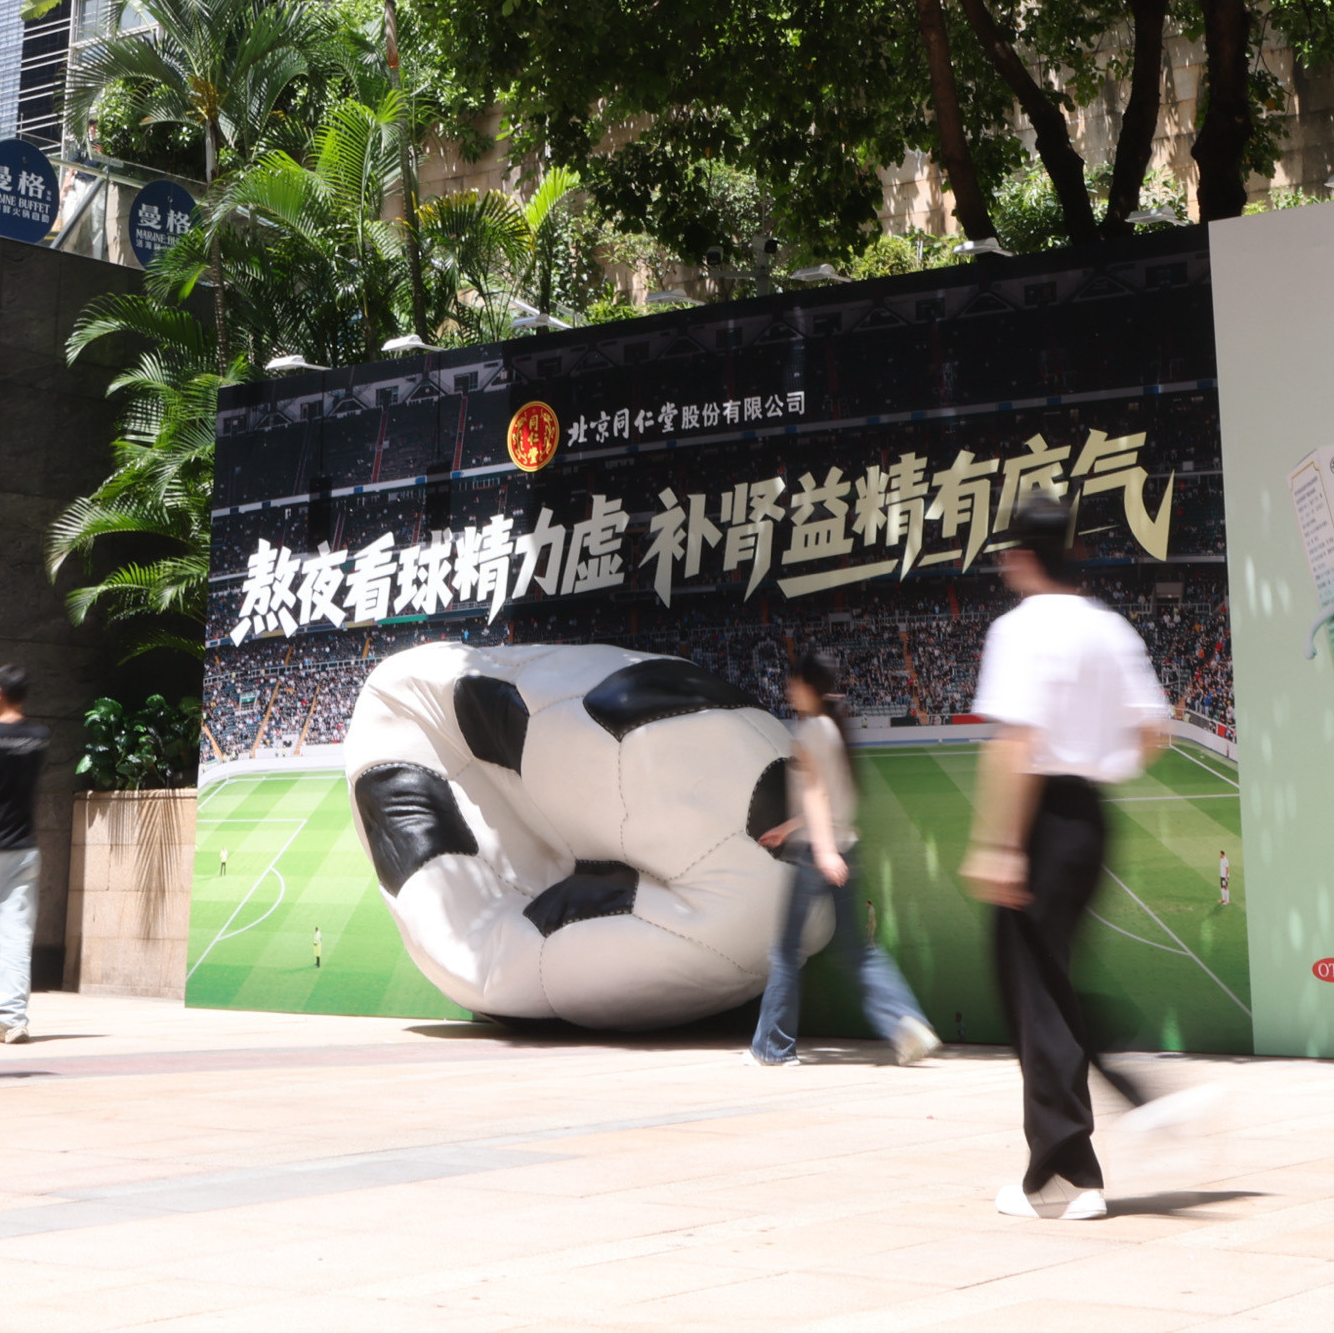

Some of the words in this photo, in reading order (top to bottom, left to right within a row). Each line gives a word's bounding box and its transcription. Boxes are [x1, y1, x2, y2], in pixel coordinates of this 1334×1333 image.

[18, 197, 50, 214] BUFFET
[137, 203, 191, 235] 曼格
[136, 228, 166, 244] MARINE
[567, 391, 806, 448] 北京同仁堂股份有限公司
[229, 494, 631, 648] 熬夜看球精力虚
[639, 426, 1175, 610] 补肾益精有底气
